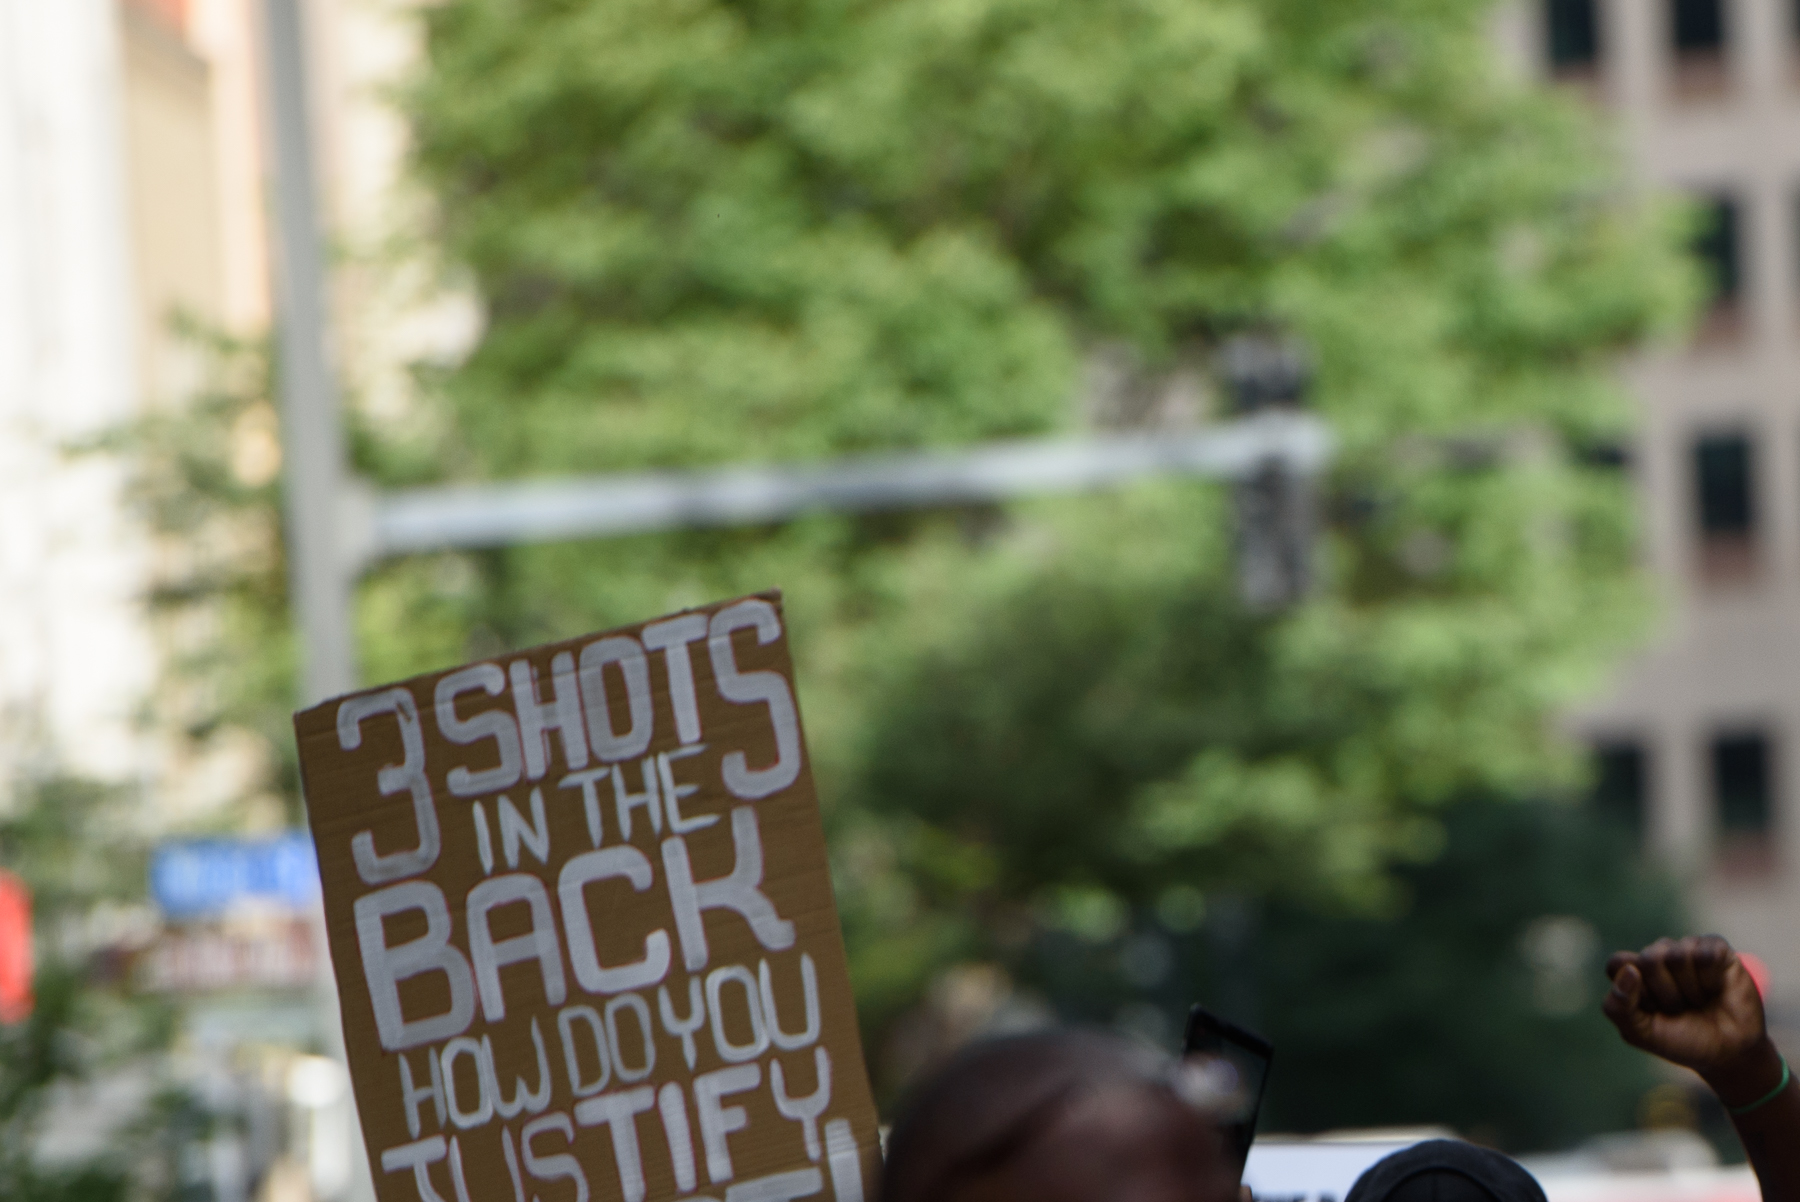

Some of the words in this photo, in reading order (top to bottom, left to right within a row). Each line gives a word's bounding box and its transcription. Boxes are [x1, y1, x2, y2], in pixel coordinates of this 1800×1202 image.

[336, 687, 441, 884] 3
[433, 598, 800, 799] SHOTS
[473, 786, 551, 875] IN
[558, 743, 721, 848] THE
[353, 806, 796, 1051] BACK
[399, 1016, 552, 1139] HOW
[557, 992, 657, 1097] DO
[659, 952, 822, 1071] YOU
